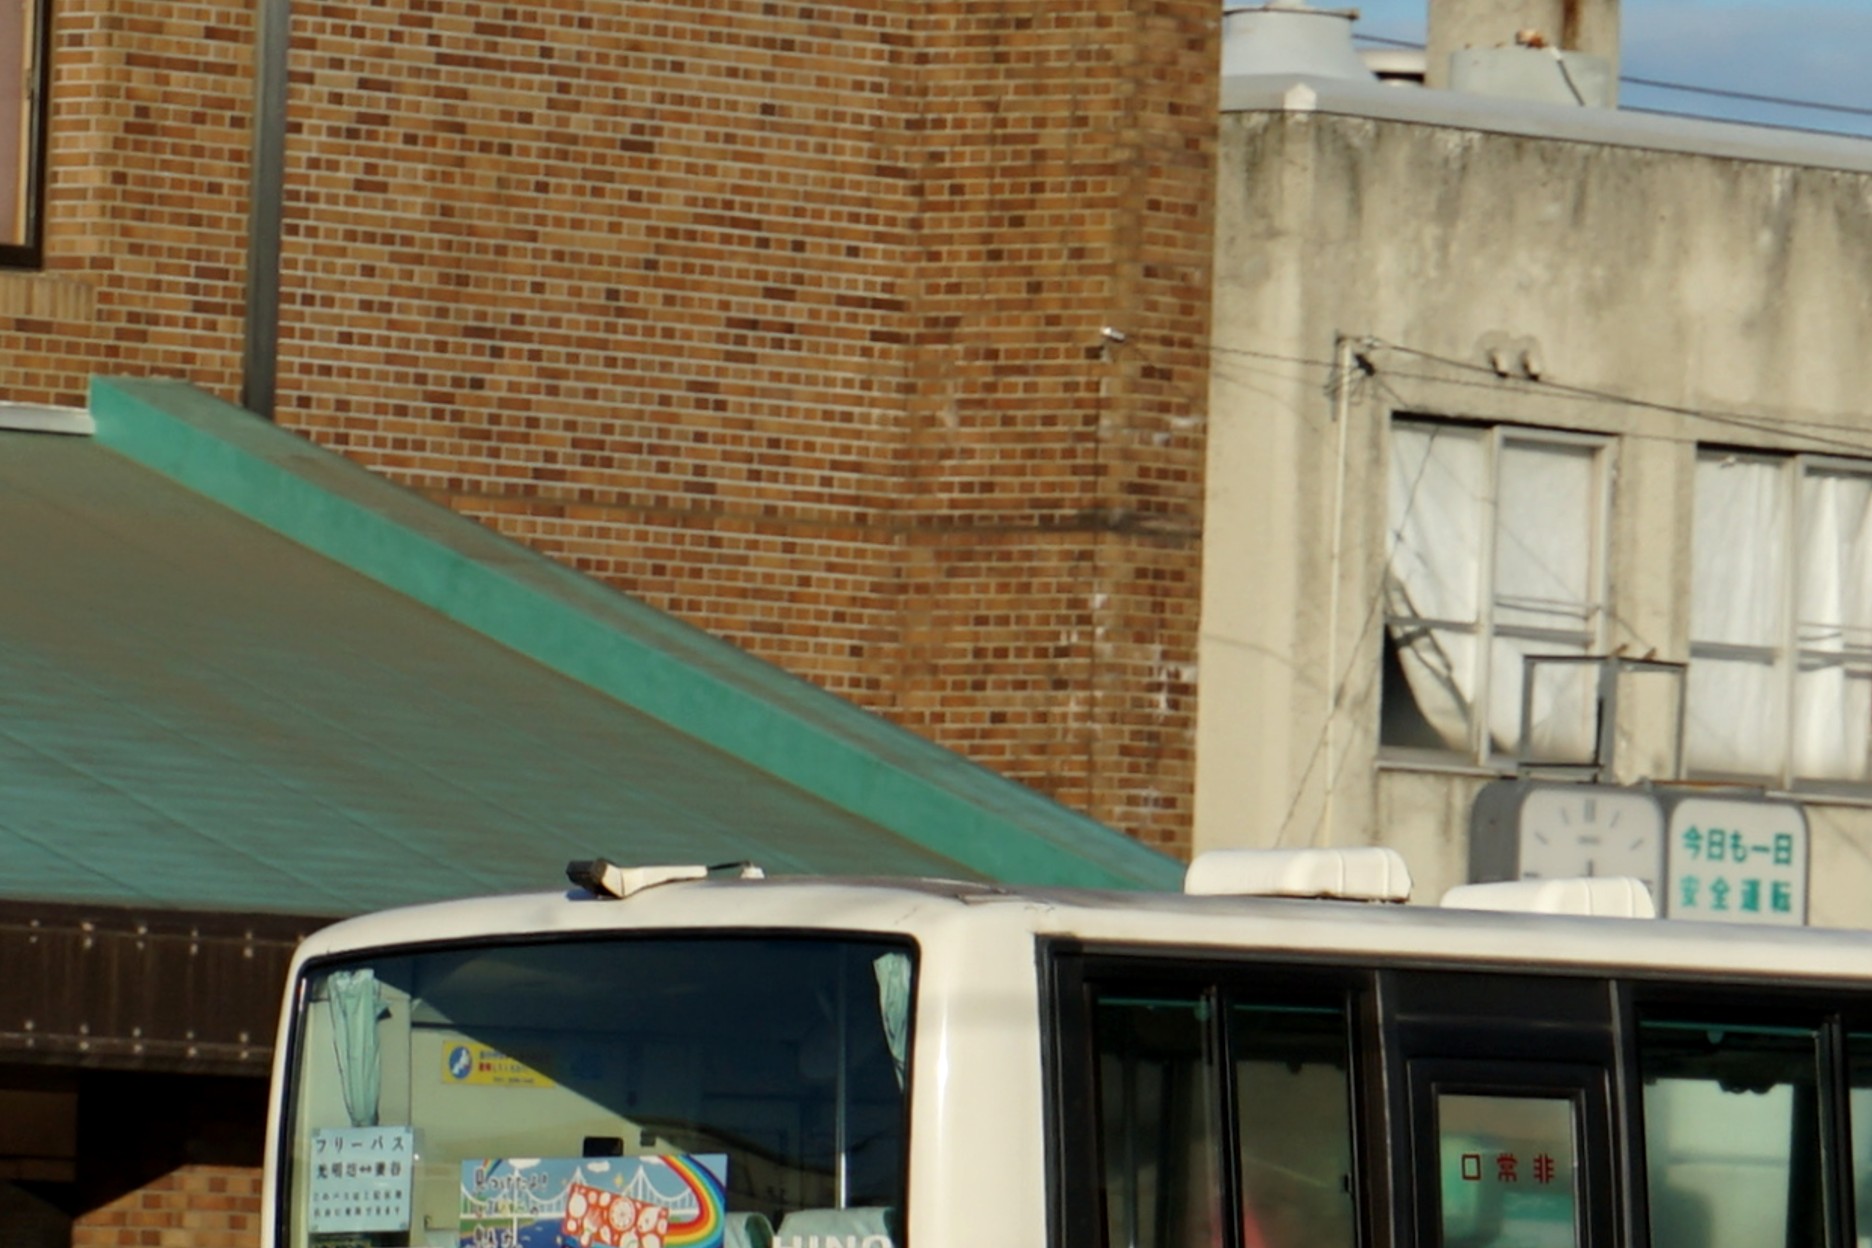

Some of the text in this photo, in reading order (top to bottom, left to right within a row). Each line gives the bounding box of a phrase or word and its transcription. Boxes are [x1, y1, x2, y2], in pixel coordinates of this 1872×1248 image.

[1683, 825, 1793, 866] 今日も一日
[316, 1135, 404, 1153] フリーバス
